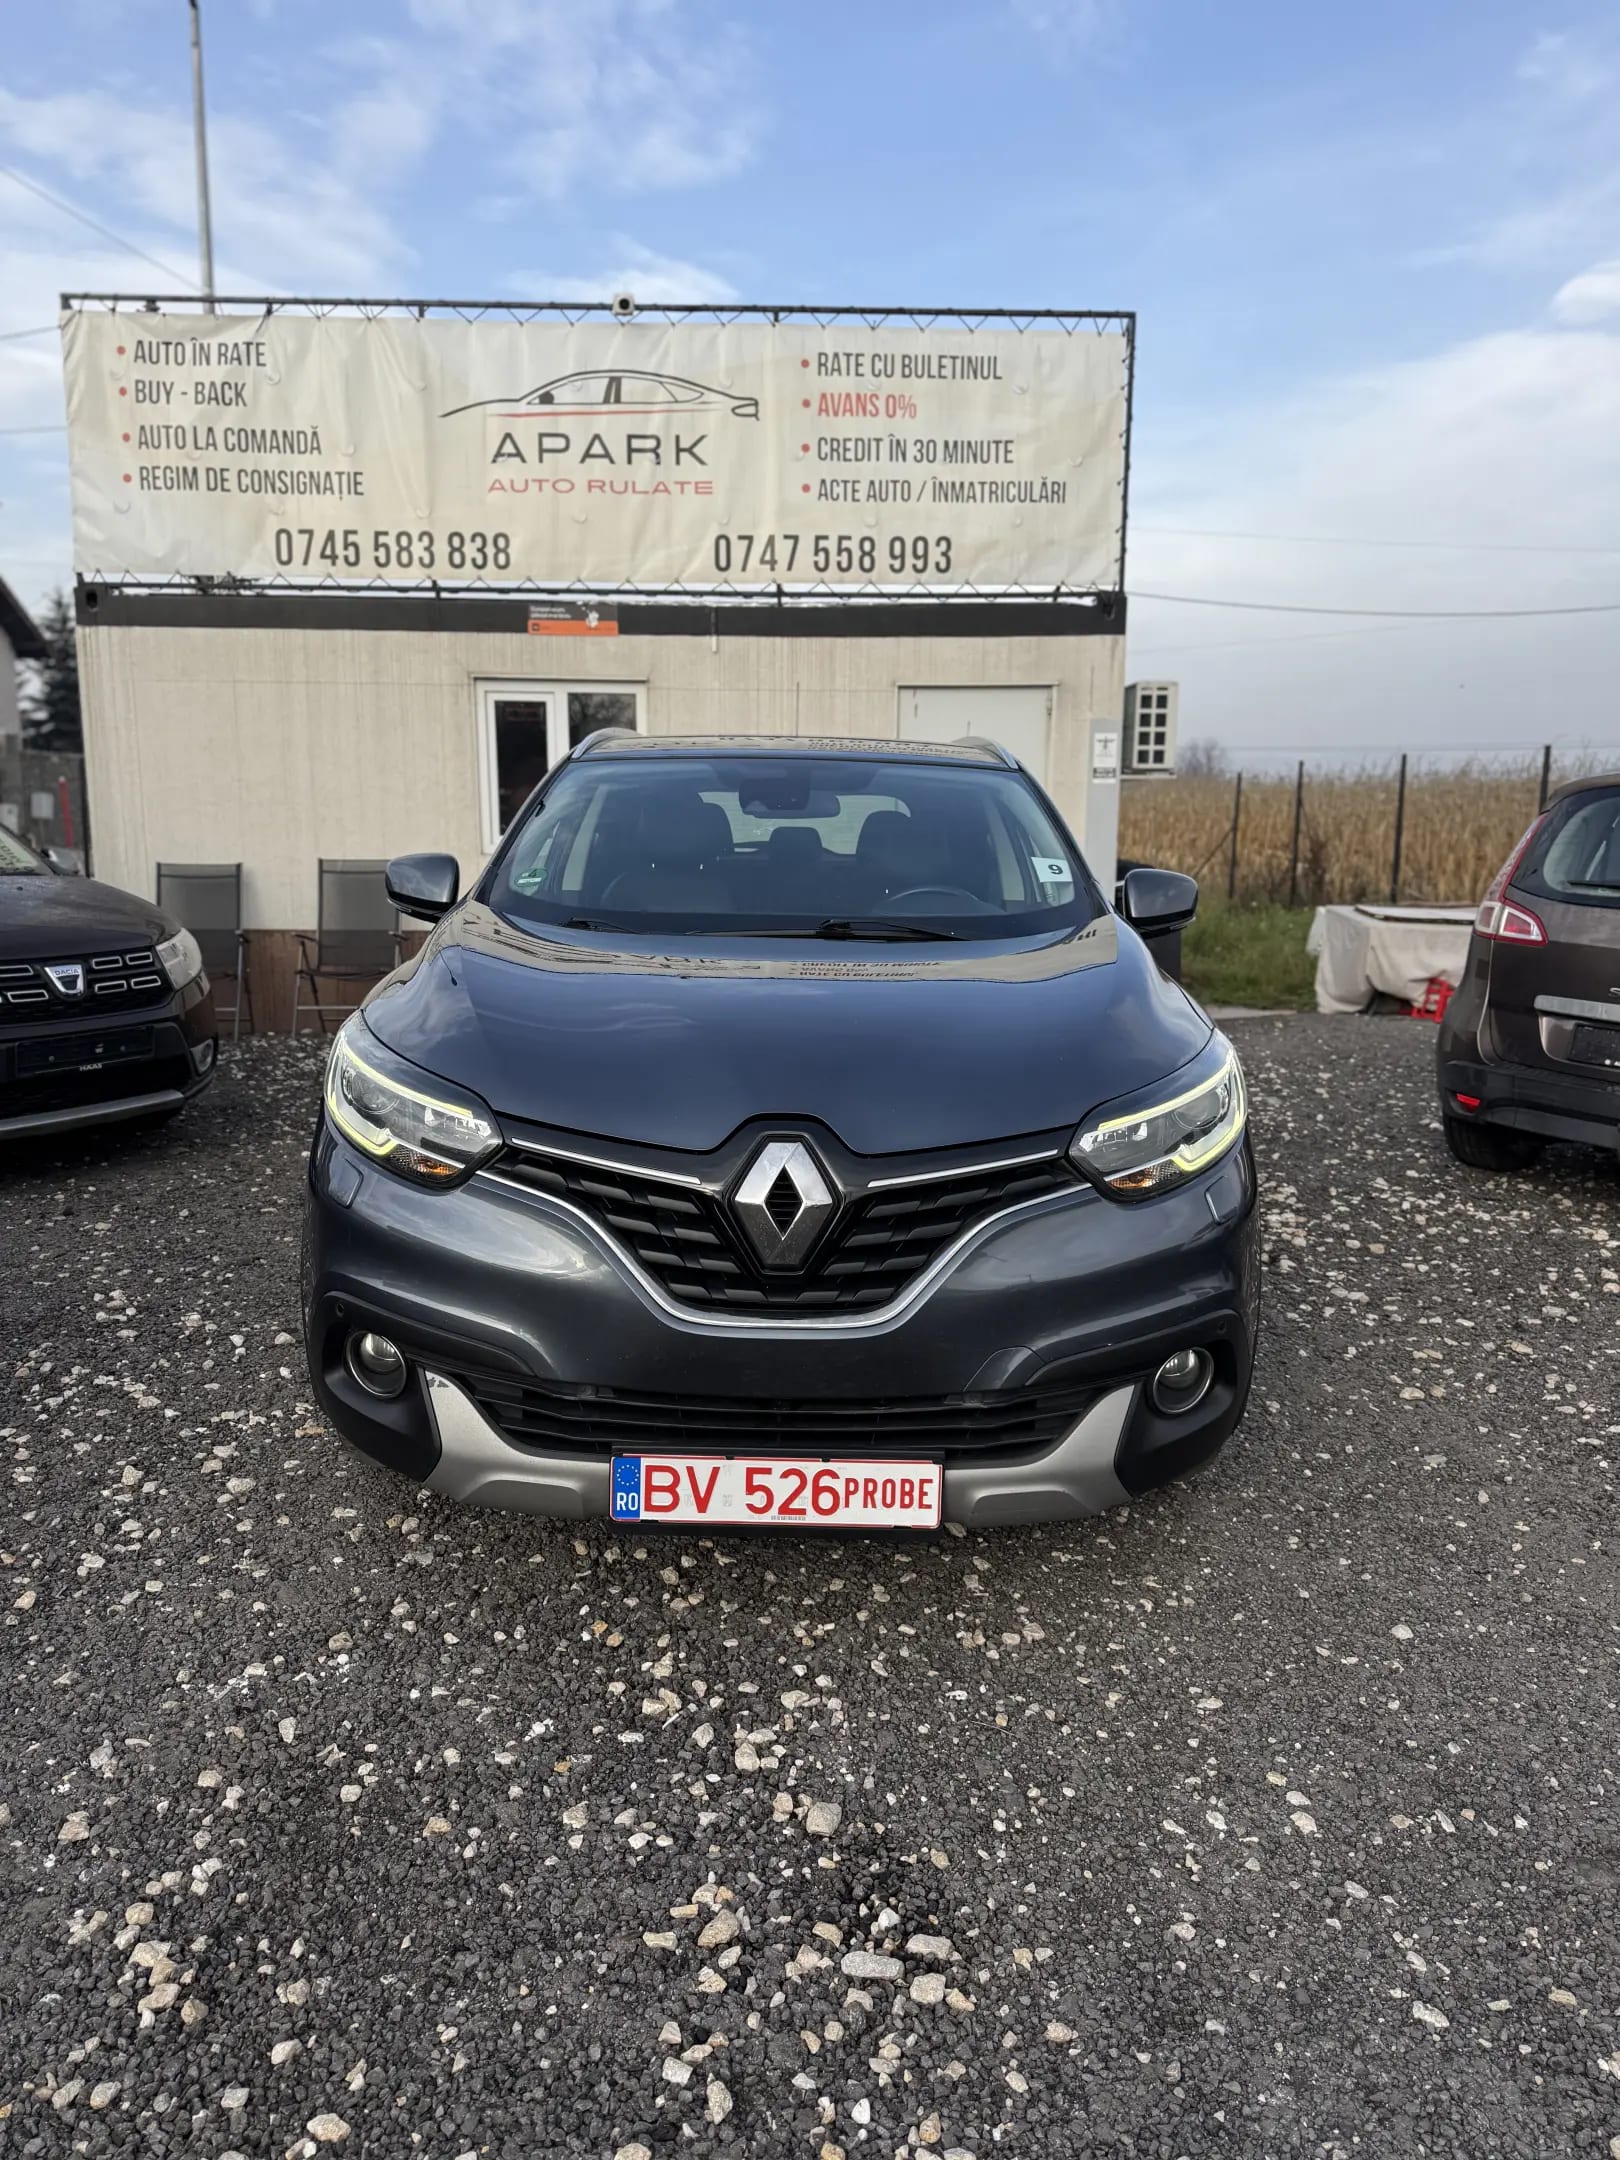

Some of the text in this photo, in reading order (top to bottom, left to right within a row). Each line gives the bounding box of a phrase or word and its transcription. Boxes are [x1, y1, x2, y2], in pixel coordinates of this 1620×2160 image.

[134, 337, 267, 367] AUTO ÎN RATE
[817, 352, 1002, 380] RATE CU BULETINUL
[135, 380, 175, 404] BUY
[194, 381, 247, 407] BACK
[817, 392, 917, 419] AVANS 0%
[138, 425, 322, 455] AUTO LA COMANDĂ
[490, 432, 709, 466] APARK
[817, 434, 1014, 464] CREDIT ÎN 30 MINUTE
[139, 466, 364, 500] REGIM DE CONSIGNAȚIE
[488, 479, 713, 495] AUTO RULATE
[817, 479, 861, 502] ACTE
[866, 480, 911, 502] AUTO
[932, 477, 1066, 504] ÎNMATRICULĂRI
[275, 528, 511, 570] 0745 583 838
[714, 534, 952, 574] 0747 558 993
[1048, 864, 1063, 875] 9
[54, 968, 79, 976] DACIA
[616, 1492, 638, 1511] RO
[644, 1465, 933, 1516] BV 526 PROBE
